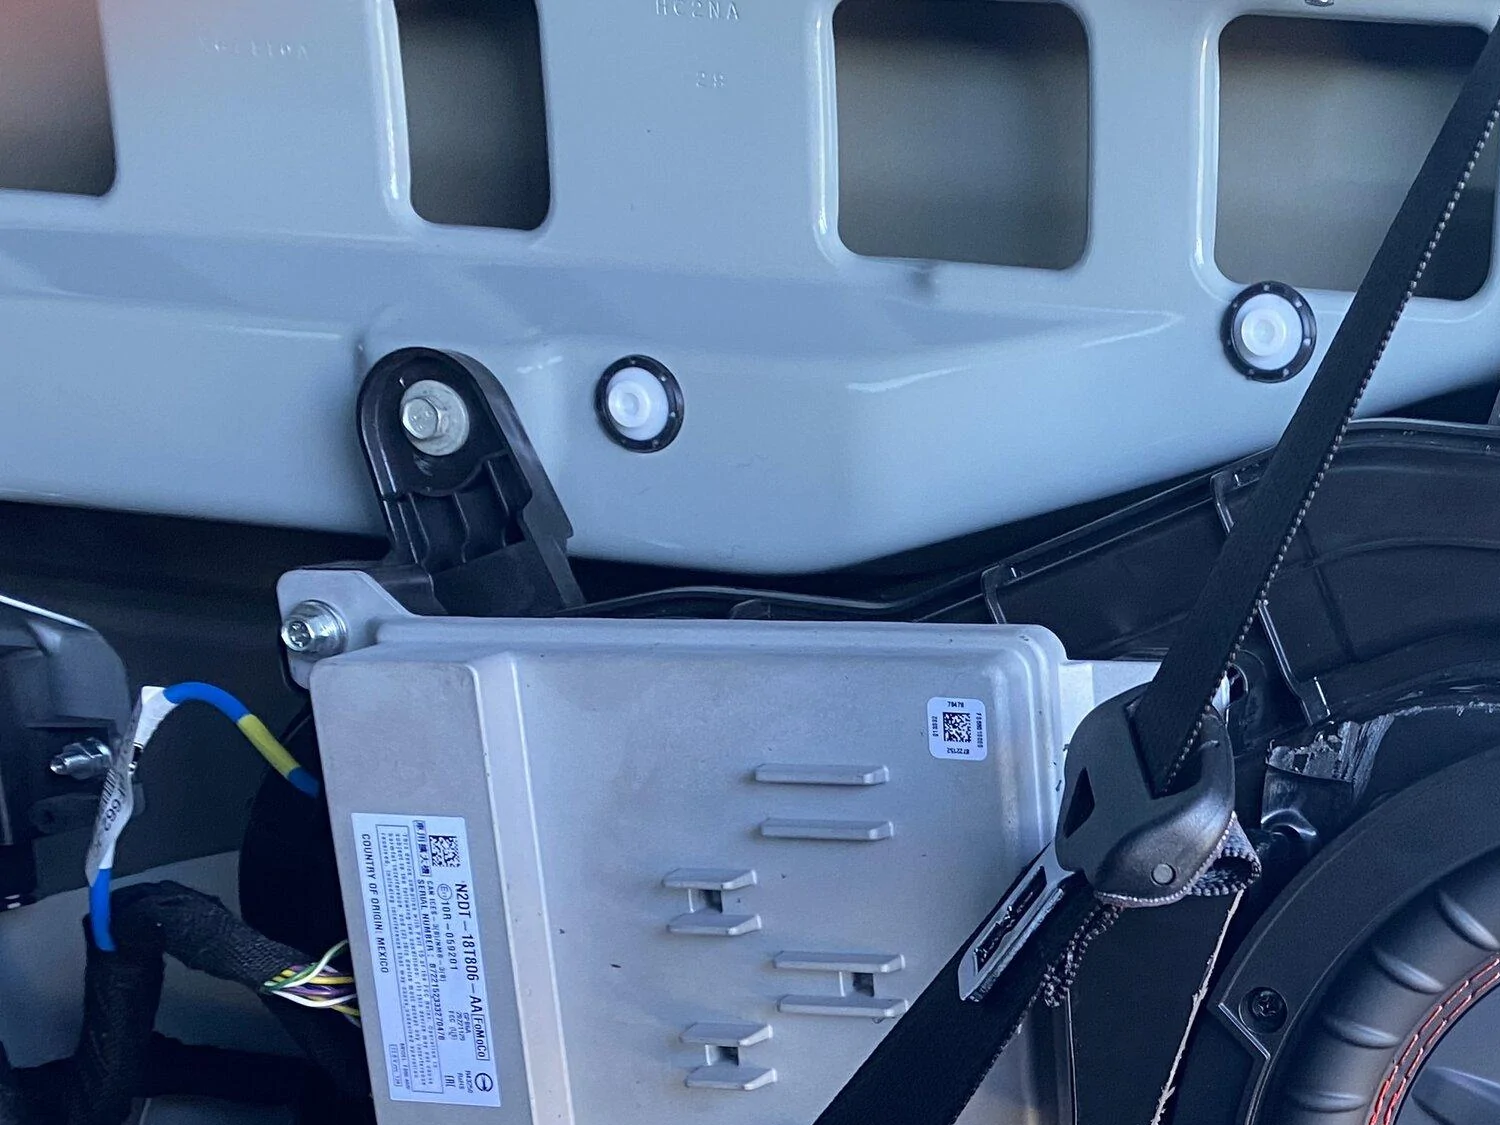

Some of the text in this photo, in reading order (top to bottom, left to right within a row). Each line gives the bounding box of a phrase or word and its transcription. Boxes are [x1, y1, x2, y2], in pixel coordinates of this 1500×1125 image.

[363, 834, 376, 880] COUNTRY
[369, 883, 378, 894] OF
[418, 880, 428, 910] SERIAL
[376, 938, 388, 973] MEXICO
[473, 1018, 488, 1058] FoMoCo
